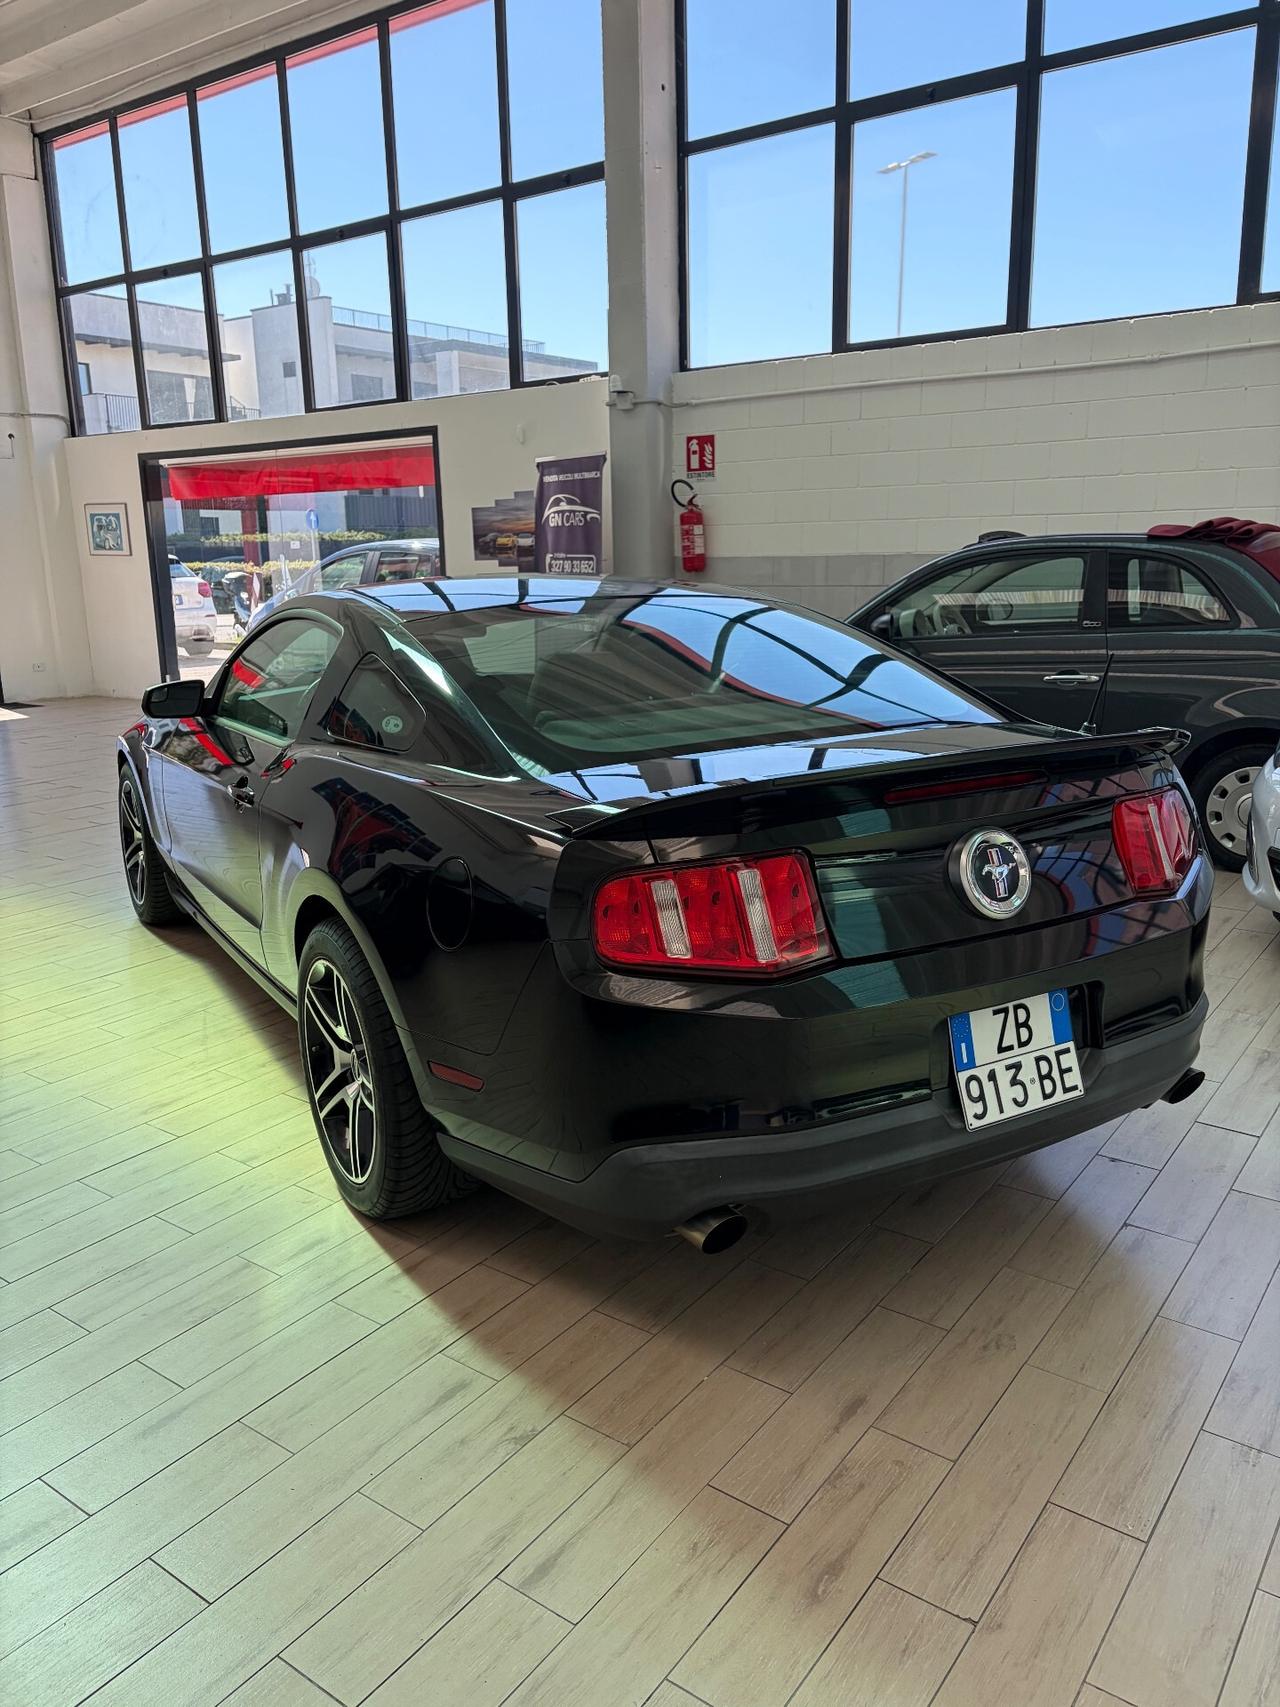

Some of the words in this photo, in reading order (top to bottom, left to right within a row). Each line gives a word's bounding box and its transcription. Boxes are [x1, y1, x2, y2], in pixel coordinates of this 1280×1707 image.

[549, 513, 562, 527] GN
[563, 512, 585, 527] CARS
[550, 560, 563, 572] 327
[992, 1003, 1033, 1054] ZB
